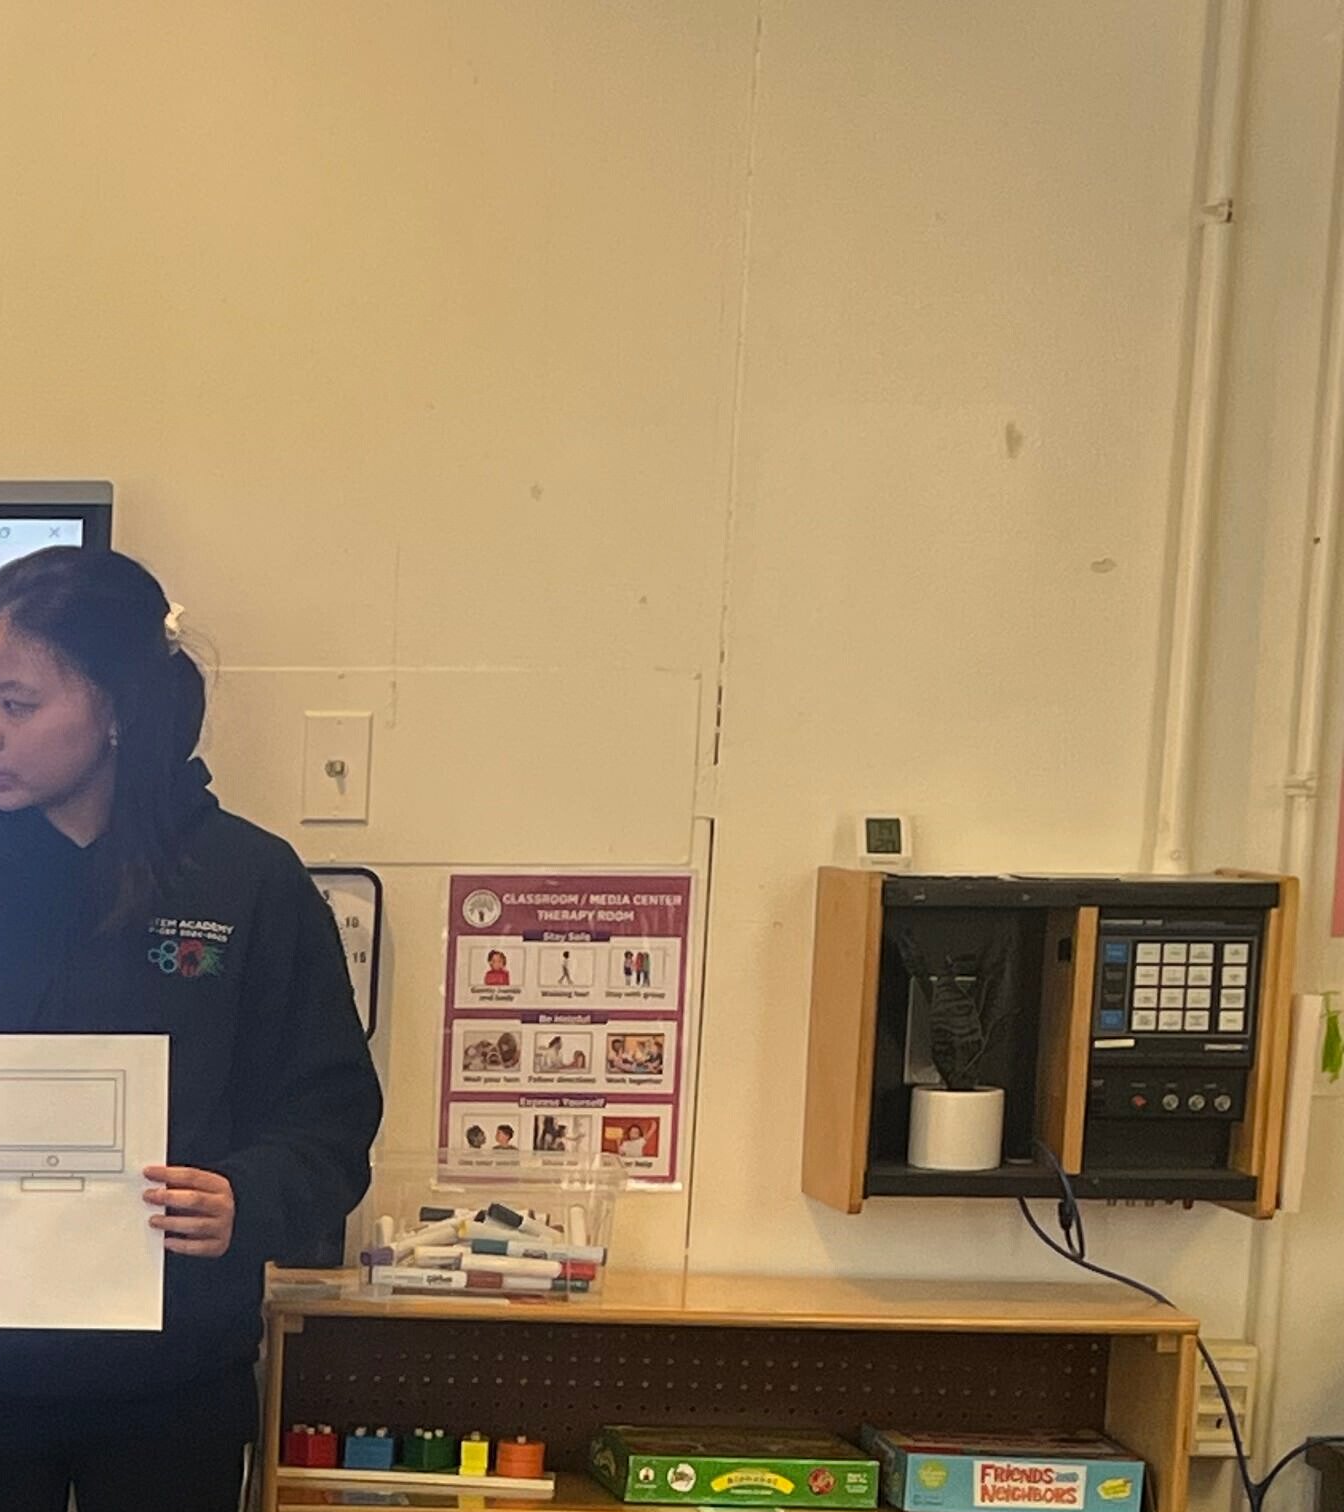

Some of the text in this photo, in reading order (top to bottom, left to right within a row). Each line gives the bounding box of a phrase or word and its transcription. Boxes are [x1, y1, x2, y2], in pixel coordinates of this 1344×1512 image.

[502, 893, 579, 905] CLASSROOM
[589, 894, 630, 905] MEDIA
[633, 894, 682, 906] CENTER
[345, 916, 360, 928] 10
[536, 910, 635, 922] THERAPY ROOM
[179, 919, 235, 934] ACADEMY
[543, 932, 591, 943] Stay Safe
[353, 951, 367, 963] 15
[980, 1464, 1054, 1484] FRIENDS
[980, 1485, 1079, 1504] NEIGHBORS
